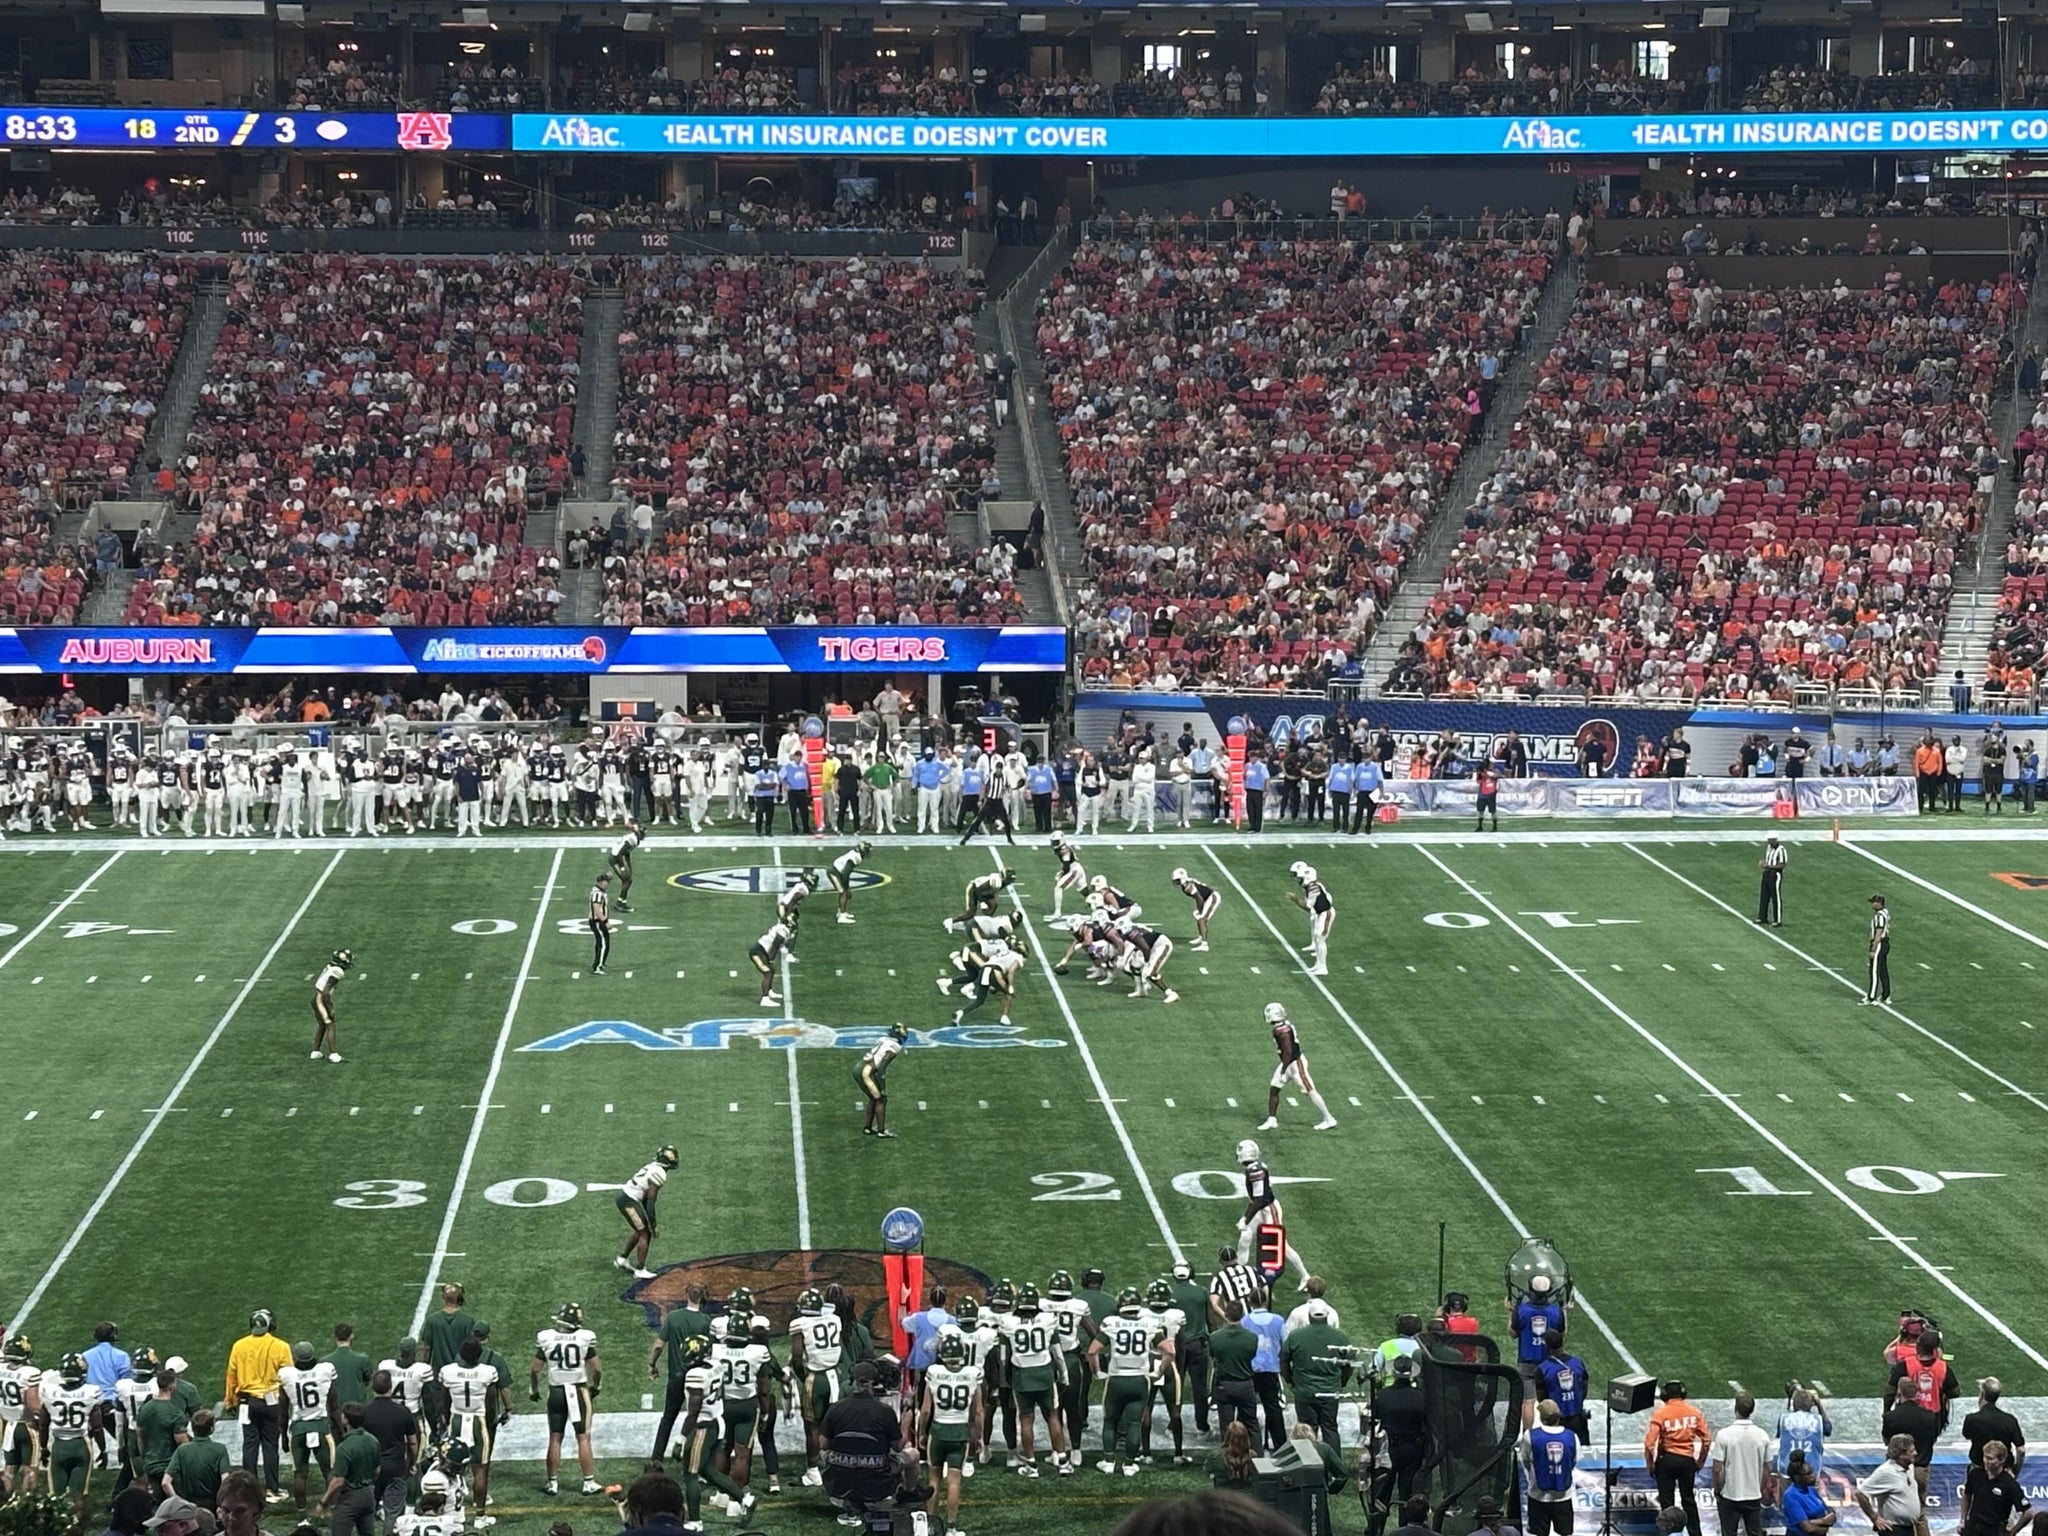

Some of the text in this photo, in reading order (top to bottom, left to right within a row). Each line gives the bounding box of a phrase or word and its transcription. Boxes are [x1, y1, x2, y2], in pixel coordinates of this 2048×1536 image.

[6, 115, 77, 140] 8:33
[125, 119, 156, 139] 18
[185, 115, 208, 125] QTR
[275, 118, 296, 143] 3
[1733, 121, 1883, 143] INSURANCE
[1891, 119, 2003, 142] DOESN'T
[175, 127, 219, 143] 2ND
[762, 124, 906, 146] INSURANCE
[913, 126, 1017, 147] DOESN'T
[1025, 127, 1107, 147] COVER
[1548, 162, 1570, 174] 113
[166, 231, 194, 243] 110C
[241, 231, 268, 244] 111C
[569, 234, 596, 246] 111C
[641, 235, 669, 247] 112C
[928, 236, 955, 248] 112C
[60, 638, 212, 664] AUBURN
[819, 637, 945, 662] TIGERS
[983, 728, 996, 752] 3
[1576, 787, 1642, 806] ESPN
[1844, 788, 1889, 804] PNC
[1262, 1226, 1283, 1270] 3
[1233, 1274, 1251, 1297] H
[813, 1322, 841, 1349] 92
[1015, 1327, 1046, 1354] 90
[1116, 1329, 1147, 1356] 98
[549, 1343, 580, 1369] 40
[296, 1382, 319, 1409] 16
[464, 1381, 471, 1408] 1
[937, 1384, 970, 1411] 98
[51, 1400, 87, 1429] 36
[1790, 1440, 1813, 1453] 112
[828, 1452, 883, 1466] CHAPMAN
